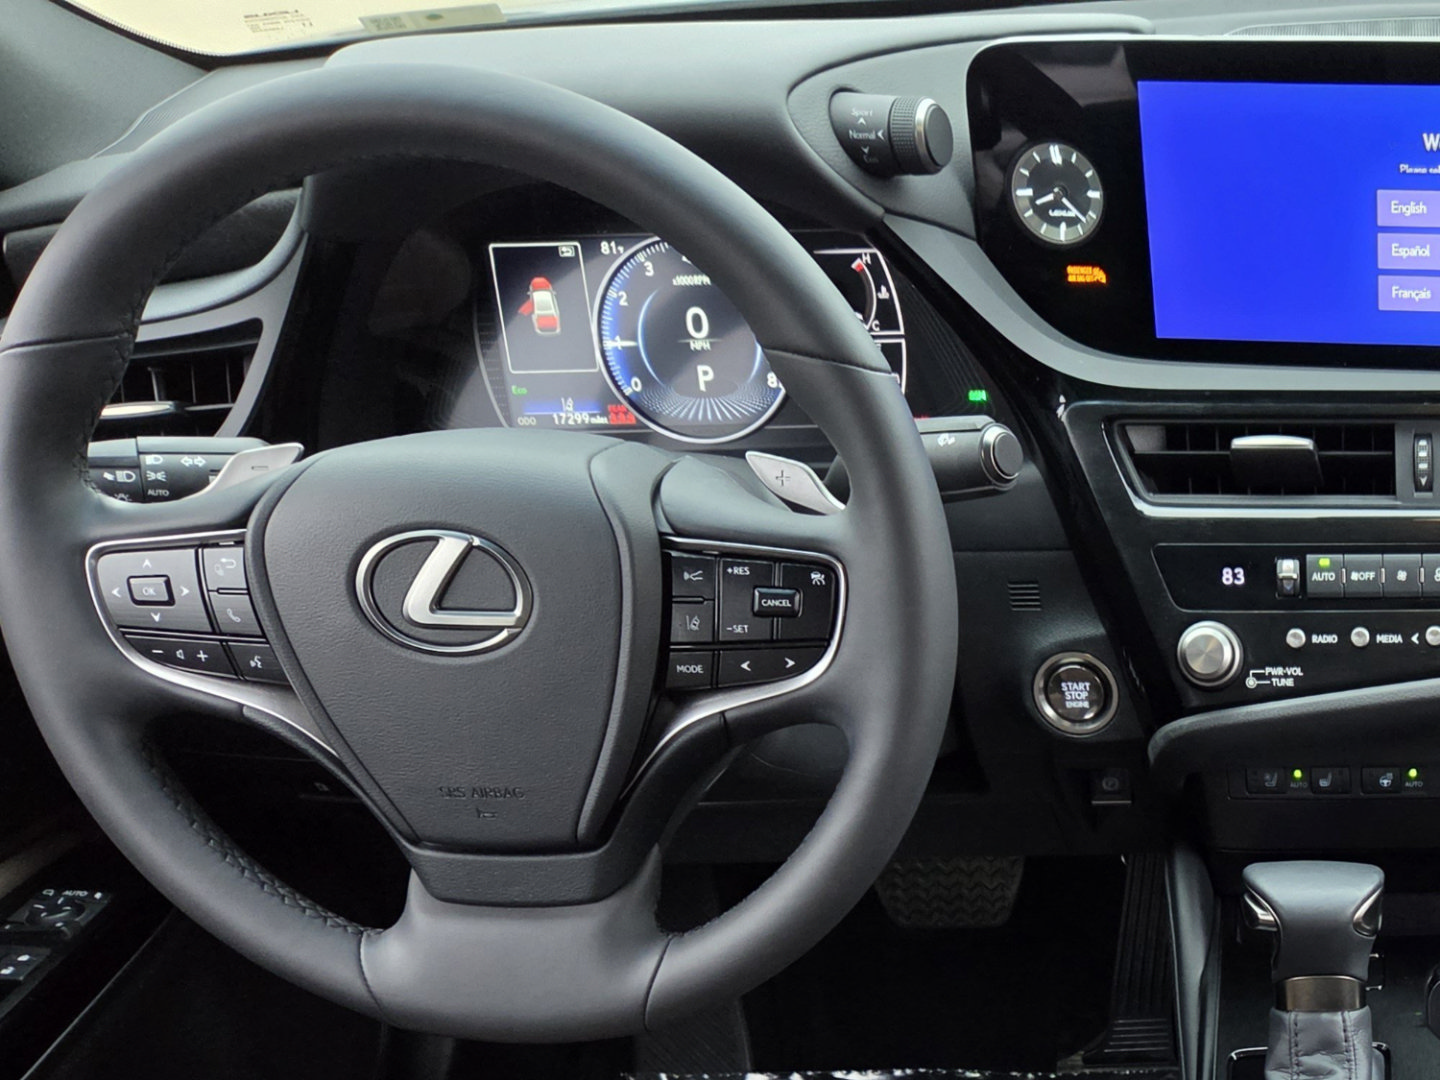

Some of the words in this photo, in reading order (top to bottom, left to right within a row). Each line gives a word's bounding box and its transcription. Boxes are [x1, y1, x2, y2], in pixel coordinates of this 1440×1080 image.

[850, 108, 873, 119] Sport
[848, 129, 876, 140] Normal
[1391, 201, 1427, 216] English
[1391, 243, 1431, 259] Español
[644, 261, 654, 276] 3
[618, 291, 629, 306] 2
[1391, 285, 1432, 302] Français
[684, 306, 710, 339] 0
[696, 364, 715, 392] P
[766, 371, 778, 388] 8
[630, 376, 642, 392] 0
[552, 413, 589, 425] 17299
[147, 488, 170, 497] AUTO
[1221, 566, 1246, 585] 83
[1311, 571, 1336, 581] AUTO
[1359, 571, 1376, 581] OFF
[142, 586, 157, 597] OK
[761, 599, 792, 608] CANCEL
[1311, 634, 1338, 644] RADIO
[1376, 634, 1403, 644] MEDIA
[676, 664, 704, 674] MODE
[1061, 682, 1091, 692] START
[1271, 678, 1295, 688] TUNE
[1064, 691, 1089, 701] STOP
[1065, 700, 1090, 709] ENGINE
[1404, 780, 1424, 788] AUTO
[439, 786, 466, 798] SRS
[471, 787, 525, 798] AIRBAG
[62, 889, 88, 897] AUTO
